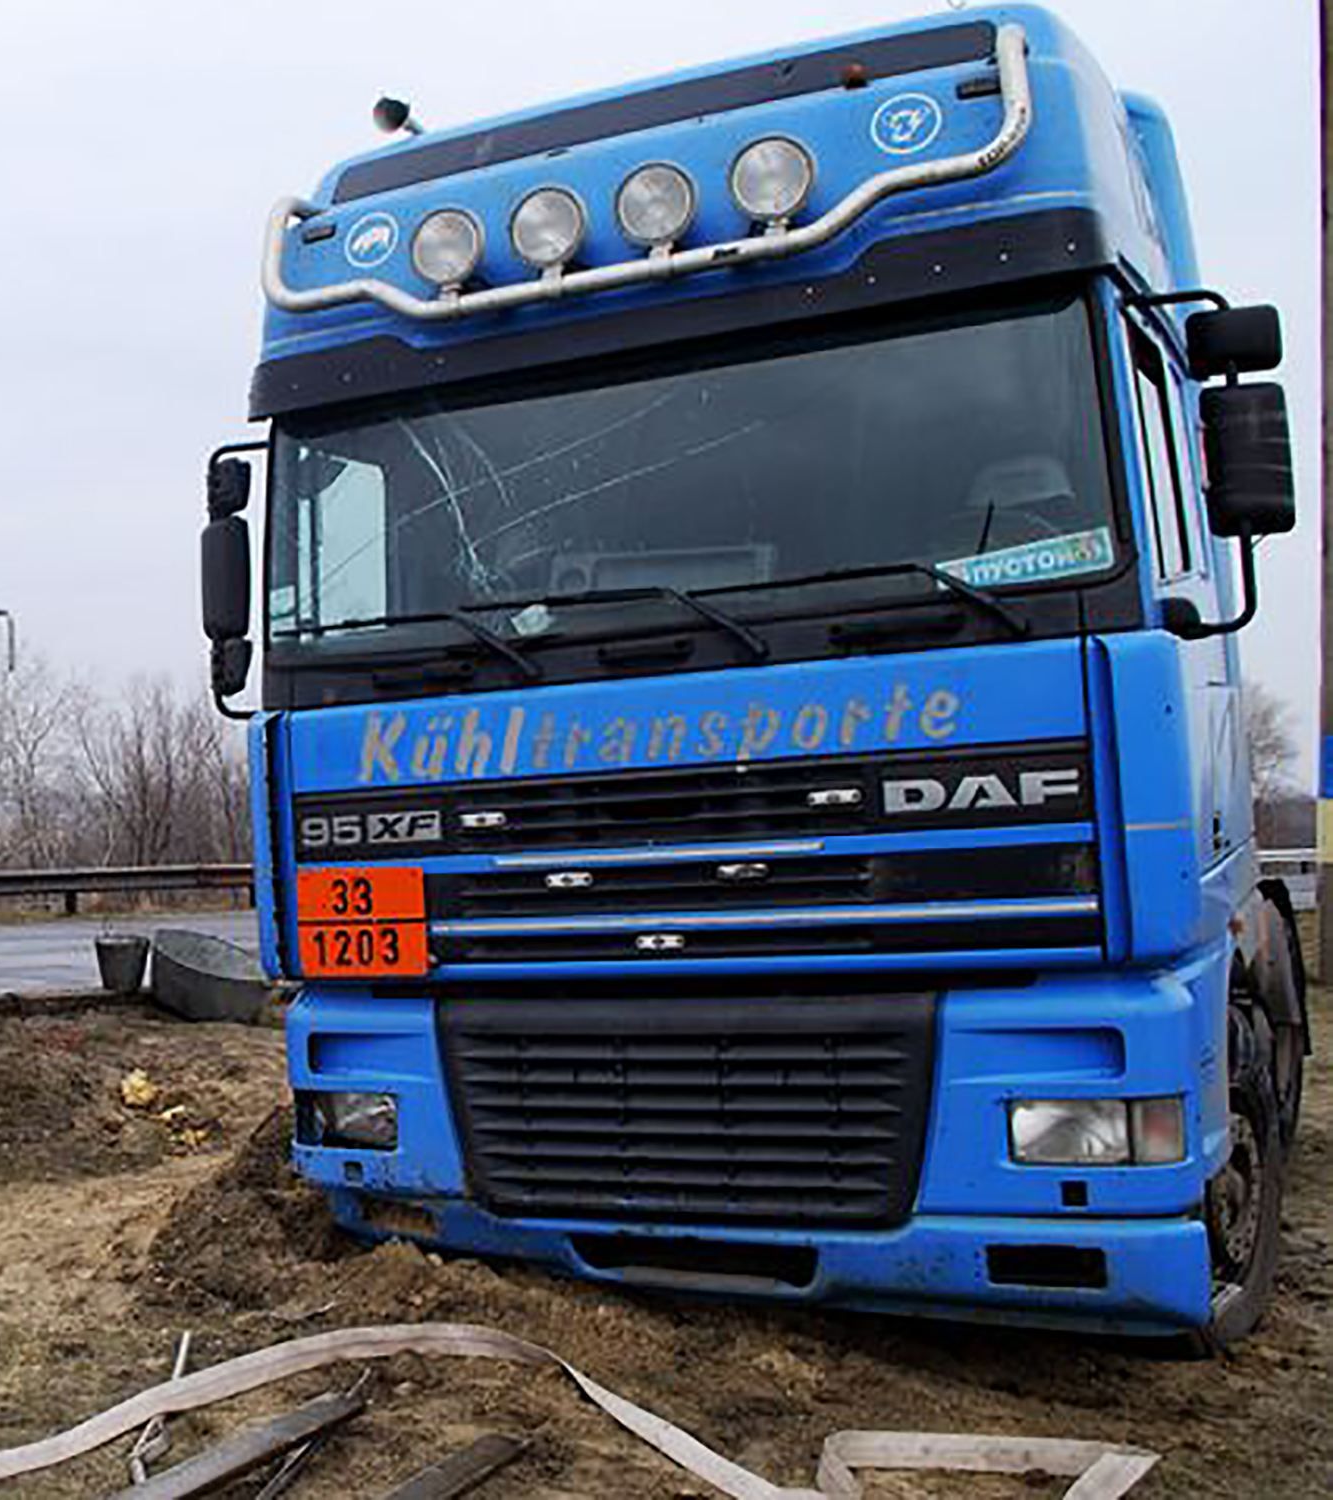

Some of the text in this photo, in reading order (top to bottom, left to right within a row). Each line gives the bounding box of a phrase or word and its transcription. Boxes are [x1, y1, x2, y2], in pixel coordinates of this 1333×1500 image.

[360, 684, 959, 780] Kühltransporte
[883, 769, 1079, 812] DAF
[331, 877, 373, 914] 33
[313, 927, 399, 966] 1203
